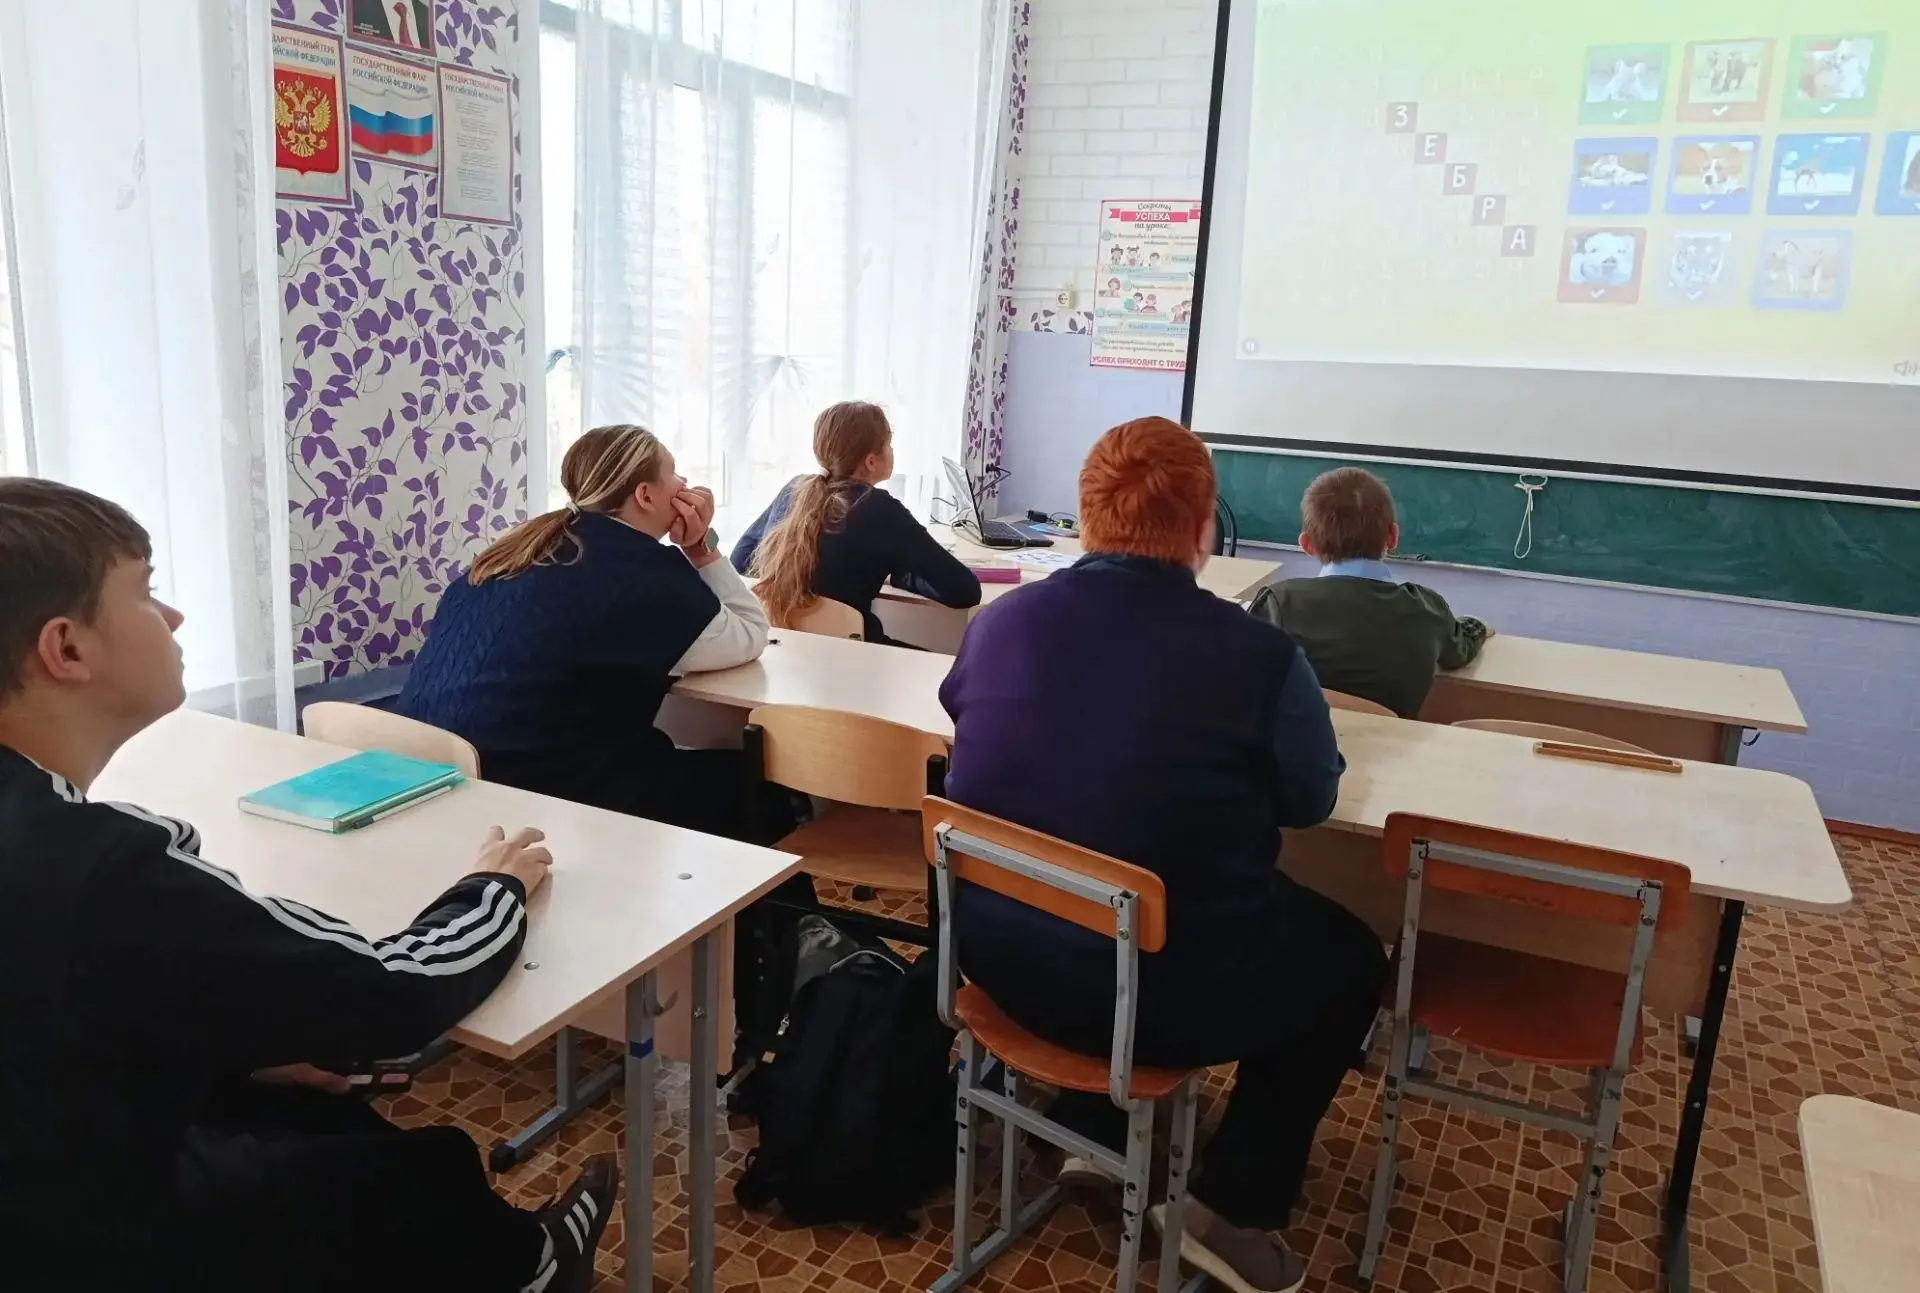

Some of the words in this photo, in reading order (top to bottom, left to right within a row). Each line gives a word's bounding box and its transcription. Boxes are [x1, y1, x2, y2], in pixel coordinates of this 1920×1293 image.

[272, 33, 320, 50] ДАРСТВЕННЫЙ
[353, 56, 411, 77] ГОСУДАРСТВЕННЫЙ
[353, 68, 392, 85] РОССИЙСКОЙ
[1135, 212, 1171, 221] УСПЕХА
[1092, 355, 1116, 364] УСПЕХ
[1117, 356, 1158, 366] ПРИХОДИТ
[1166, 360, 1186, 368] ТРУД
